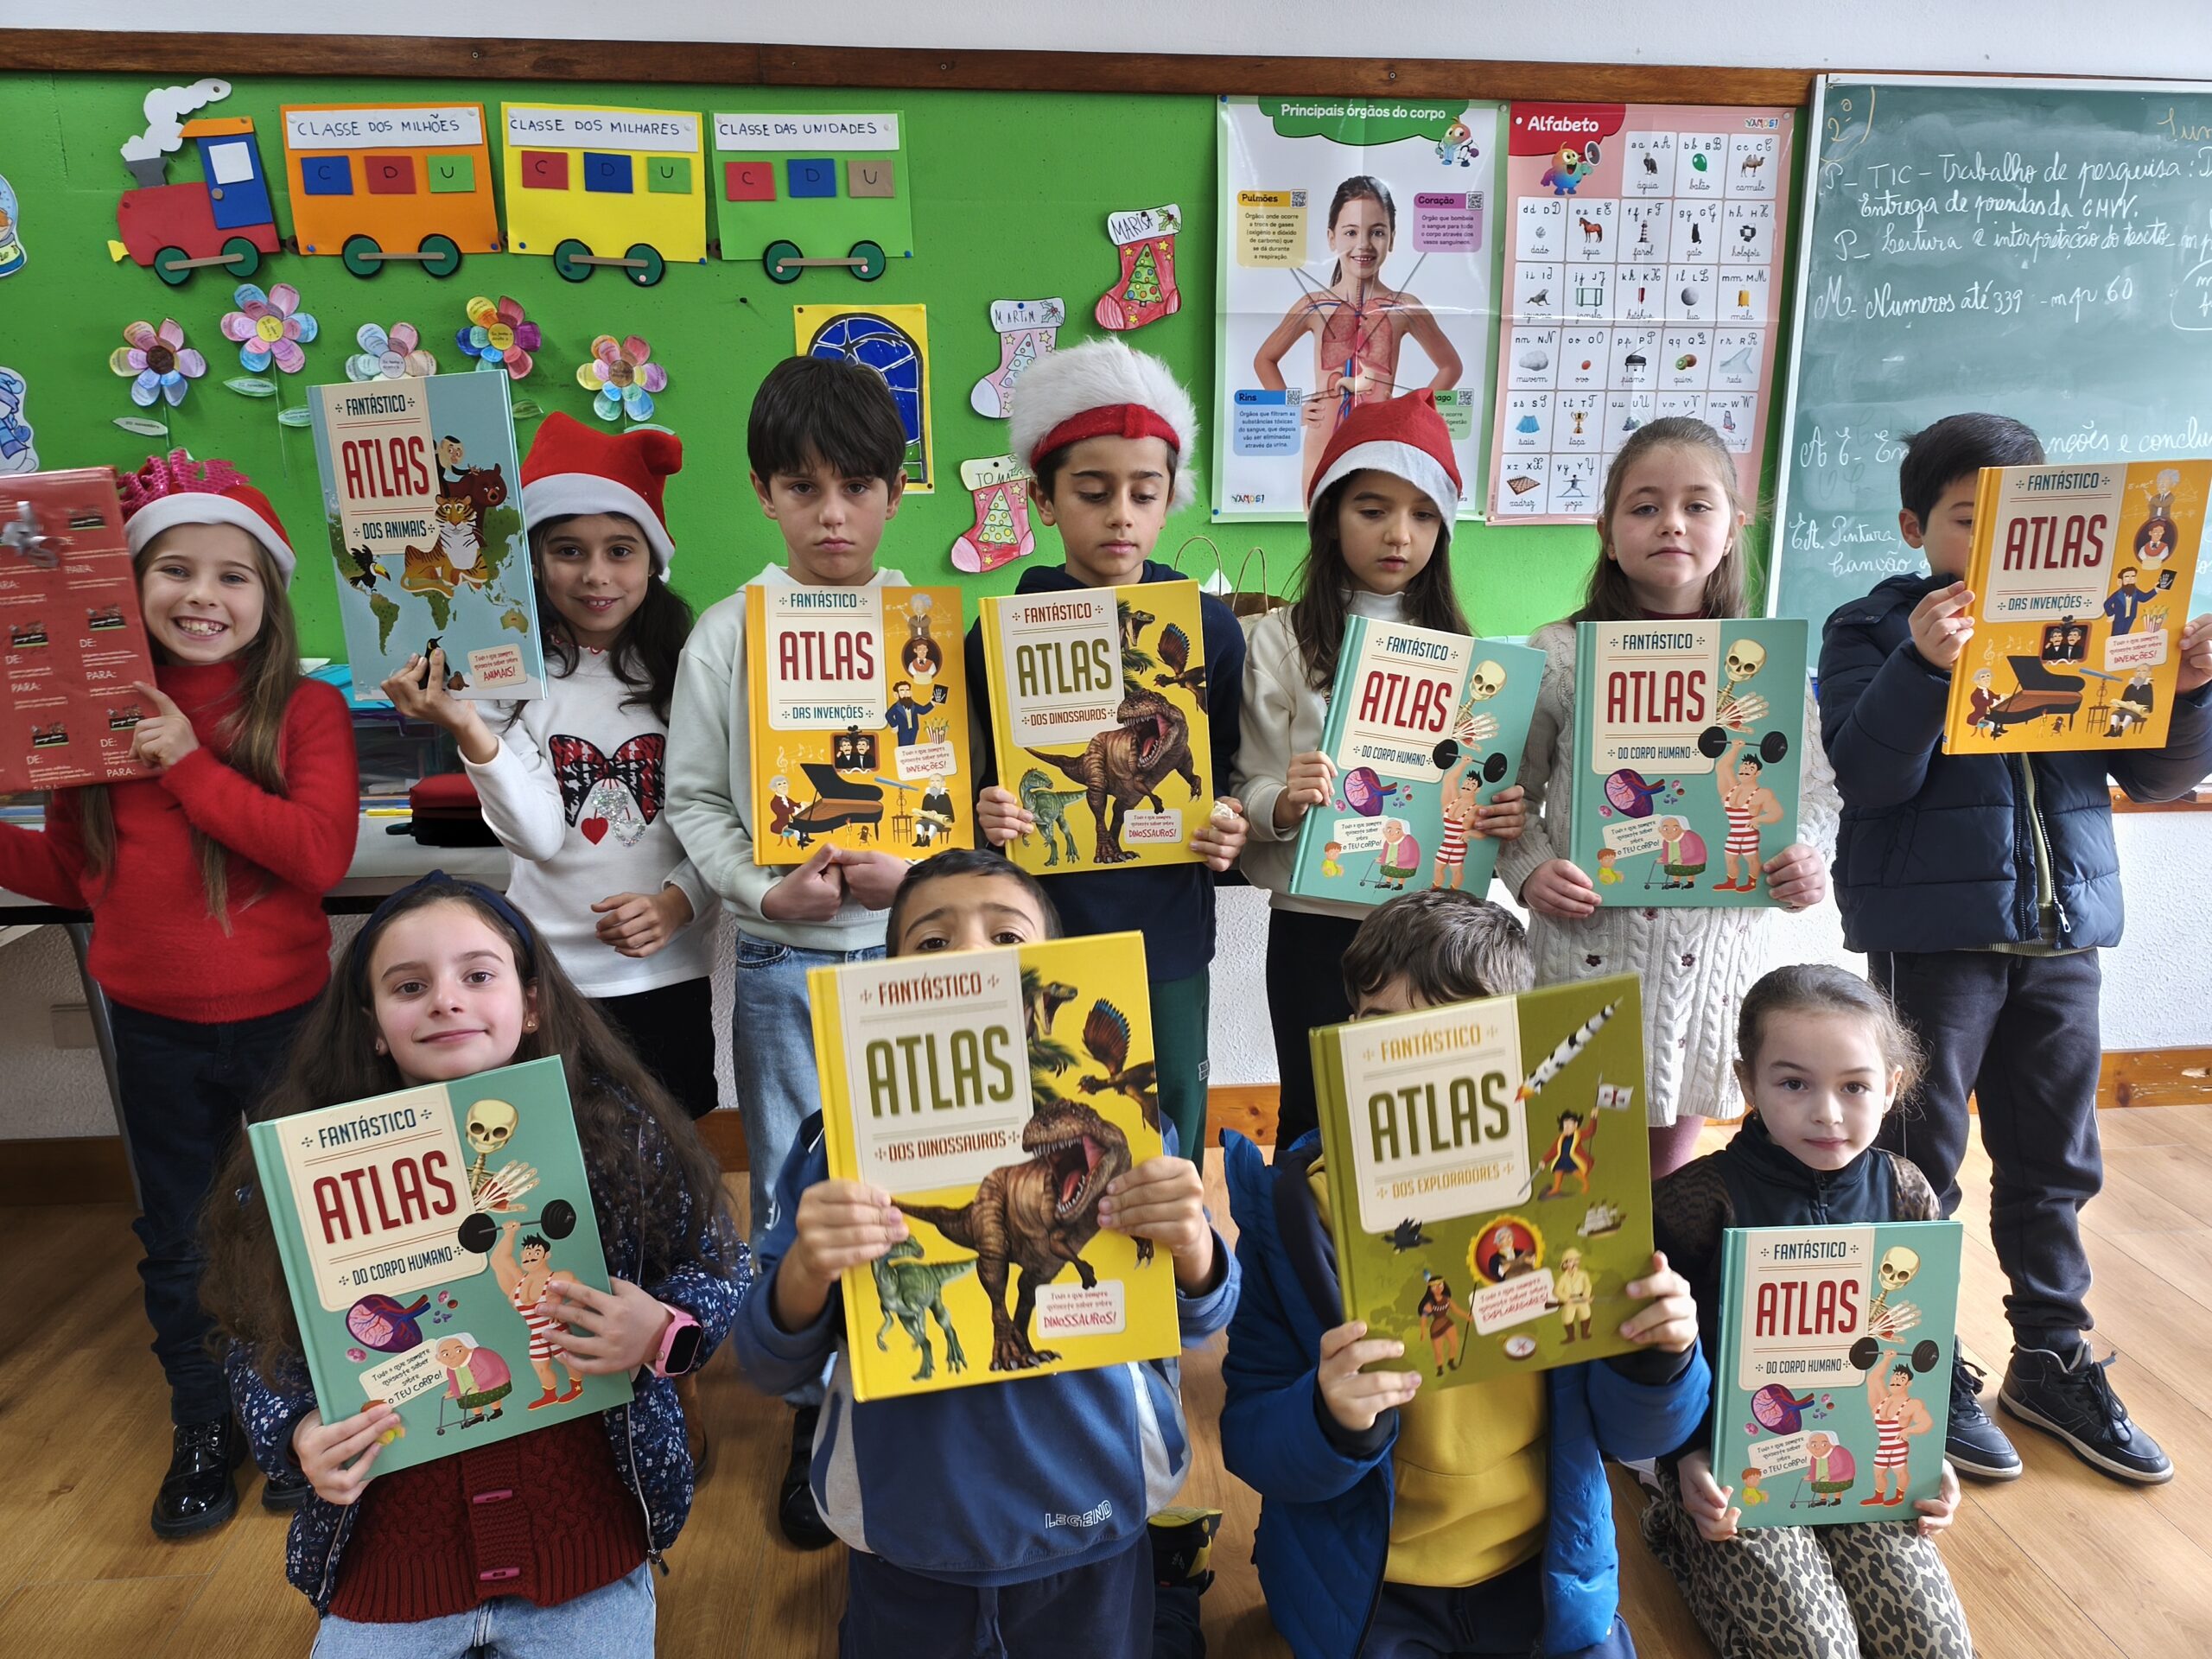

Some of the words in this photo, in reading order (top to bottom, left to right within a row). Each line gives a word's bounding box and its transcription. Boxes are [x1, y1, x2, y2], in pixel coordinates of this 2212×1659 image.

[1281, 105, 1344, 118] Principais
[1347, 105, 1390, 119] órgãos
[1393, 108, 1408, 119] do
[1410, 109, 1446, 120] corpo
[297, 119, 361, 137] CLASSE
[368, 119, 393, 134] DOS
[402, 114, 460, 134] MILHÕES
[510, 117, 565, 133] CLASSE
[575, 119, 602, 132] DOS
[610, 120, 681, 137] MILHARES
[719, 121, 770, 137] CLASSE
[774, 123, 798, 136] DAS
[804, 121, 877, 135] UNIDADES
[1528, 117, 1599, 132] Alfabeto
[1745, 118, 1778, 129] VAMOS!
[317, 165, 331, 180] C
[384, 166, 397, 179] D
[441, 166, 454, 178] U
[536, 160, 548, 175] C
[601, 162, 615, 175] D
[662, 166, 674, 178] U
[806, 168, 819, 181] D
[1868, 164, 1911, 188] TIC
[1939, 152, 2037, 182] Trabalho
[2044, 151, 2069, 182] de
[741, 171, 754, 185] C
[863, 169, 877, 184] U
[1637, 181, 1659, 194] águia
[1689, 179, 1710, 190] balão
[1736, 181, 1765, 191] camelo
[1243, 194, 1278, 202] Pulmões
[1418, 196, 1454, 205] Coração
[1859, 190, 1938, 225] Entrega
[1945, 192, 1968, 213] de
[2049, 194, 2073, 218] da
[1531, 245, 1549, 254] dado
[1881, 223, 1961, 255] Leitura
[1973, 229, 1986, 247] e
[1993, 223, 2099, 263] interpretação
[2101, 229, 2119, 250] do
[1633, 245, 1654, 260] farol
[1687, 247, 1702, 261] gato
[1732, 243, 1760, 260] holofote
[1961, 281, 1993, 311] até
[1994, 290, 2022, 314] 339
[2107, 276, 2133, 301] 60
[1687, 309, 1700, 320] lua
[1731, 310, 1754, 320] mala
[1621, 375, 1645, 386] piano
[1726, 374, 1743, 383] rede
[346, 394, 405, 416] FANTÁSTICO
[1569, 436, 1586, 447] taça
[342, 435, 429, 499] ATLAS
[2027, 471, 2100, 491] FANTÁSTICO
[1231, 494, 1264, 503] VAMOS!
[1510, 499, 1535, 510] xadrez
[1565, 499, 1583, 511] yoga
[363, 522, 383, 539] DOS
[386, 520, 427, 538] ANIMAIS
[2004, 514, 2107, 570] ATLAS
[791, 591, 856, 607] FANTÁSTICO
[2008, 598, 2027, 610] DAS
[2031, 594, 2082, 611] INVENÇÕES
[1025, 602, 1091, 623] FANTÁSTICO
[79, 639, 97, 648] DE:
[1623, 631, 1693, 650] FANTÁSTICO
[780, 632, 874, 680] ATLAS
[1386, 638, 1448, 661] FANTÁSTICO
[6, 655, 22, 664] DE:
[484, 666, 516, 681] ANIMAIS!
[1016, 639, 1112, 696] ATLAS
[86, 671, 117, 680] PARA:
[12, 683, 41, 692] PARA:
[1359, 671, 1452, 732] ATLAS
[1607, 671, 1705, 723] ATLAS
[792, 707, 810, 718] DAS
[814, 704, 863, 721] INVENÇÕES
[1031, 712, 1047, 726] DOS
[1049, 709, 1107, 725] DINOSSAUROS
[100, 739, 118, 747] DE:
[26, 755, 43, 765] DE:
[1362, 746, 1372, 758] DO
[1373, 747, 1395, 762] CORPO
[1397, 752, 1426, 766] HUMANO
[1618, 747, 1629, 760] DO
[1630, 747, 1656, 759] CORPO
[1658, 747, 1690, 759] HUMANO
[106, 767, 136, 778] PARA:
[879, 973, 982, 1006] FANTÁSTICO
[1381, 1025, 1481, 1062] FANTÁSTICO
[866, 1026, 1014, 1118] ATLAS
[1369, 1072, 1510, 1163] ATLAS
[319, 1109, 416, 1148] FANTÁSTICO
[889, 1141, 914, 1161] DOS
[918, 1131, 1006, 1160] DINOSSAUROS
[1393, 1182, 1414, 1199] DOS
[1417, 1165, 1500, 1194] EXPLORADORES
[313, 1150, 457, 1244] ATLAS
[1774, 1240, 1847, 1260] FANTÁSTICO
[353, 1268, 368, 1286] DO
[370, 1261, 406, 1281] CORPO
[408, 1247, 454, 1271] HUMANO
[1756, 1280, 1859, 1337] ATLAS
[372, 1370, 388, 1381] Tudo
[394, 1362, 405, 1370] que
[407, 1349, 430, 1363] sempre
[382, 1369, 410, 1386] quiseste
[411, 1359, 429, 1370] saber
[1766, 1362, 1777, 1374] DO
[1780, 1360, 1806, 1373] CORPO
[1808, 1358, 1841, 1372] HUMANO
[402, 1374, 419, 1386] sobre
[394, 1387, 411, 1401] TEU
[1769, 1465, 1782, 1473] TEU
[1046, 1500, 1112, 1529] LEGEND
